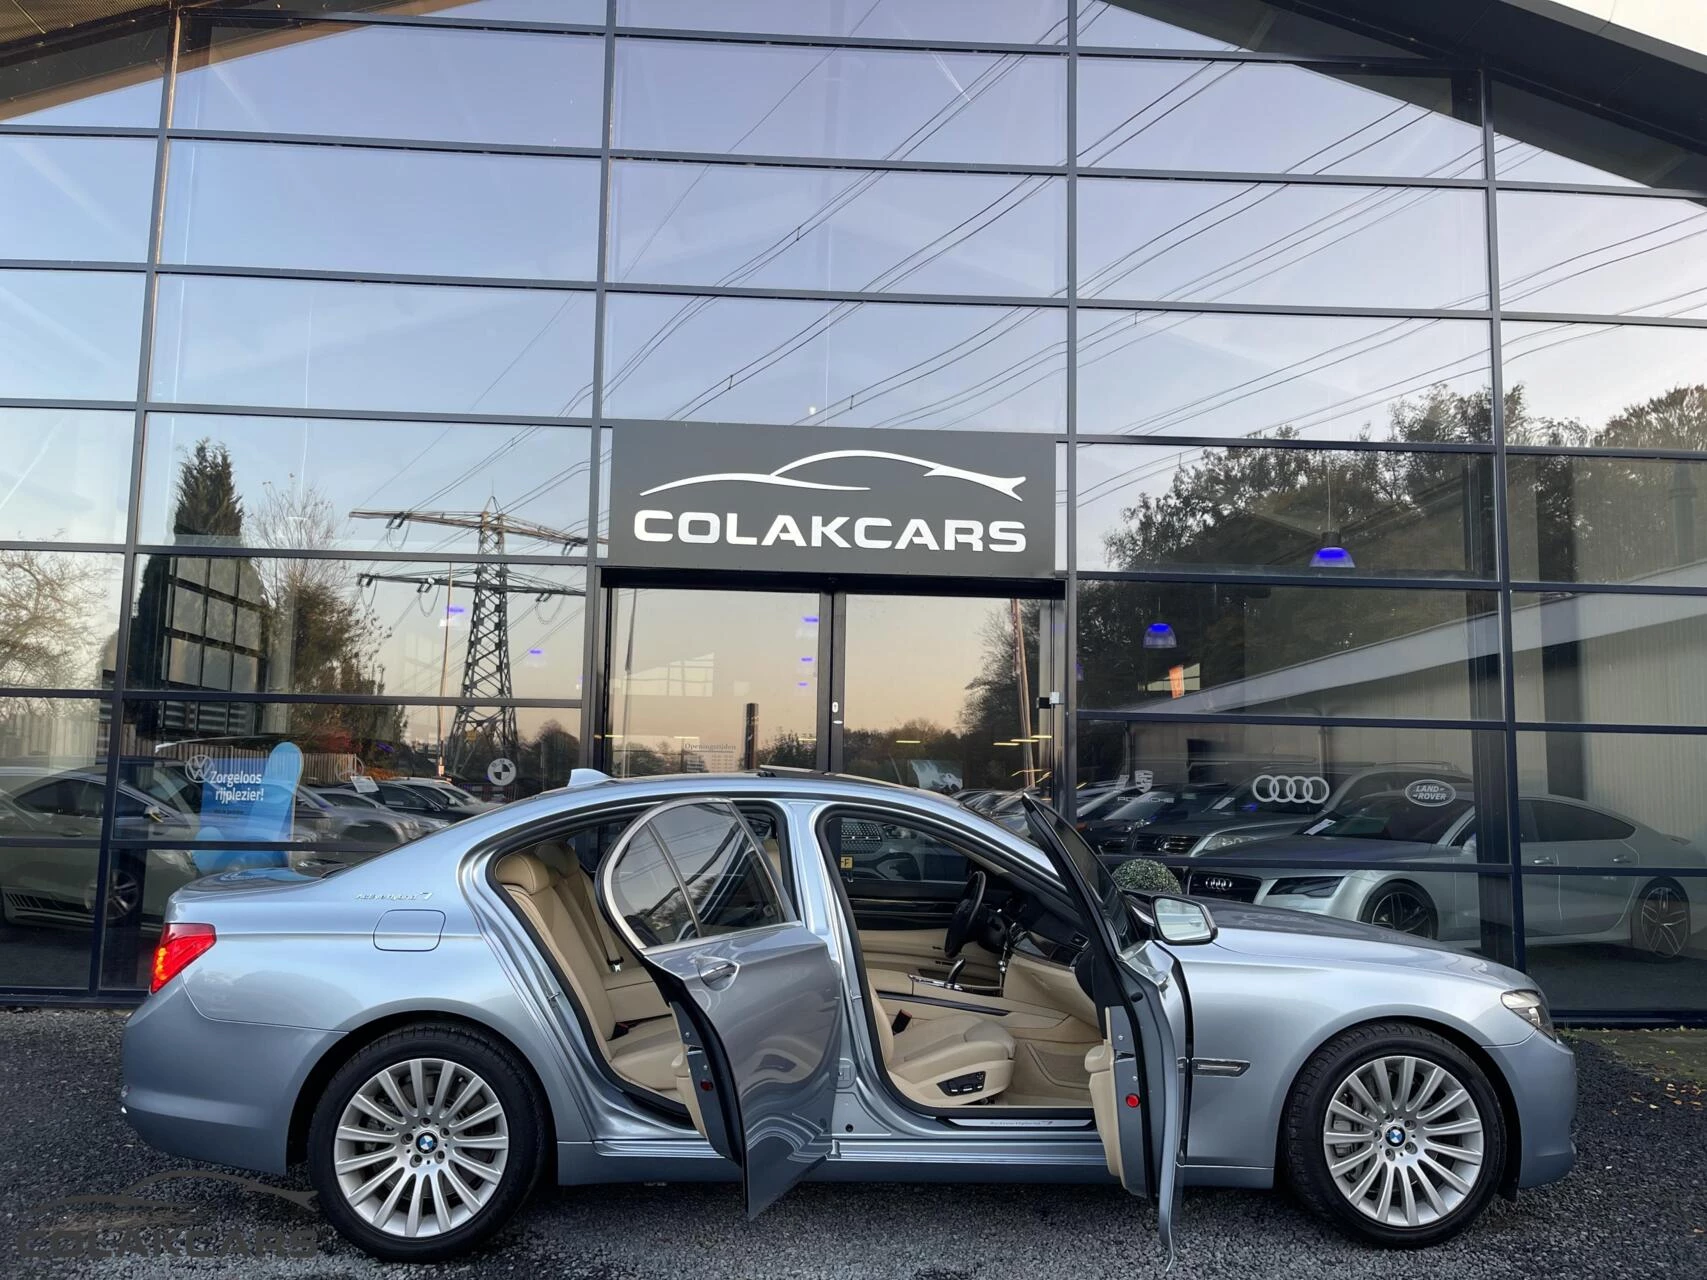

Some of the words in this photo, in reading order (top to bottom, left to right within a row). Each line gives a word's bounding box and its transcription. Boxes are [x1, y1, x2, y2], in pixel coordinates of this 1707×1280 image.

[633, 509, 1027, 553] COLAKCARS
[209, 770, 262, 787] Zorgeloos
[215, 788, 264, 804] rijplezier!
[1415, 785, 1440, 793] LAND
